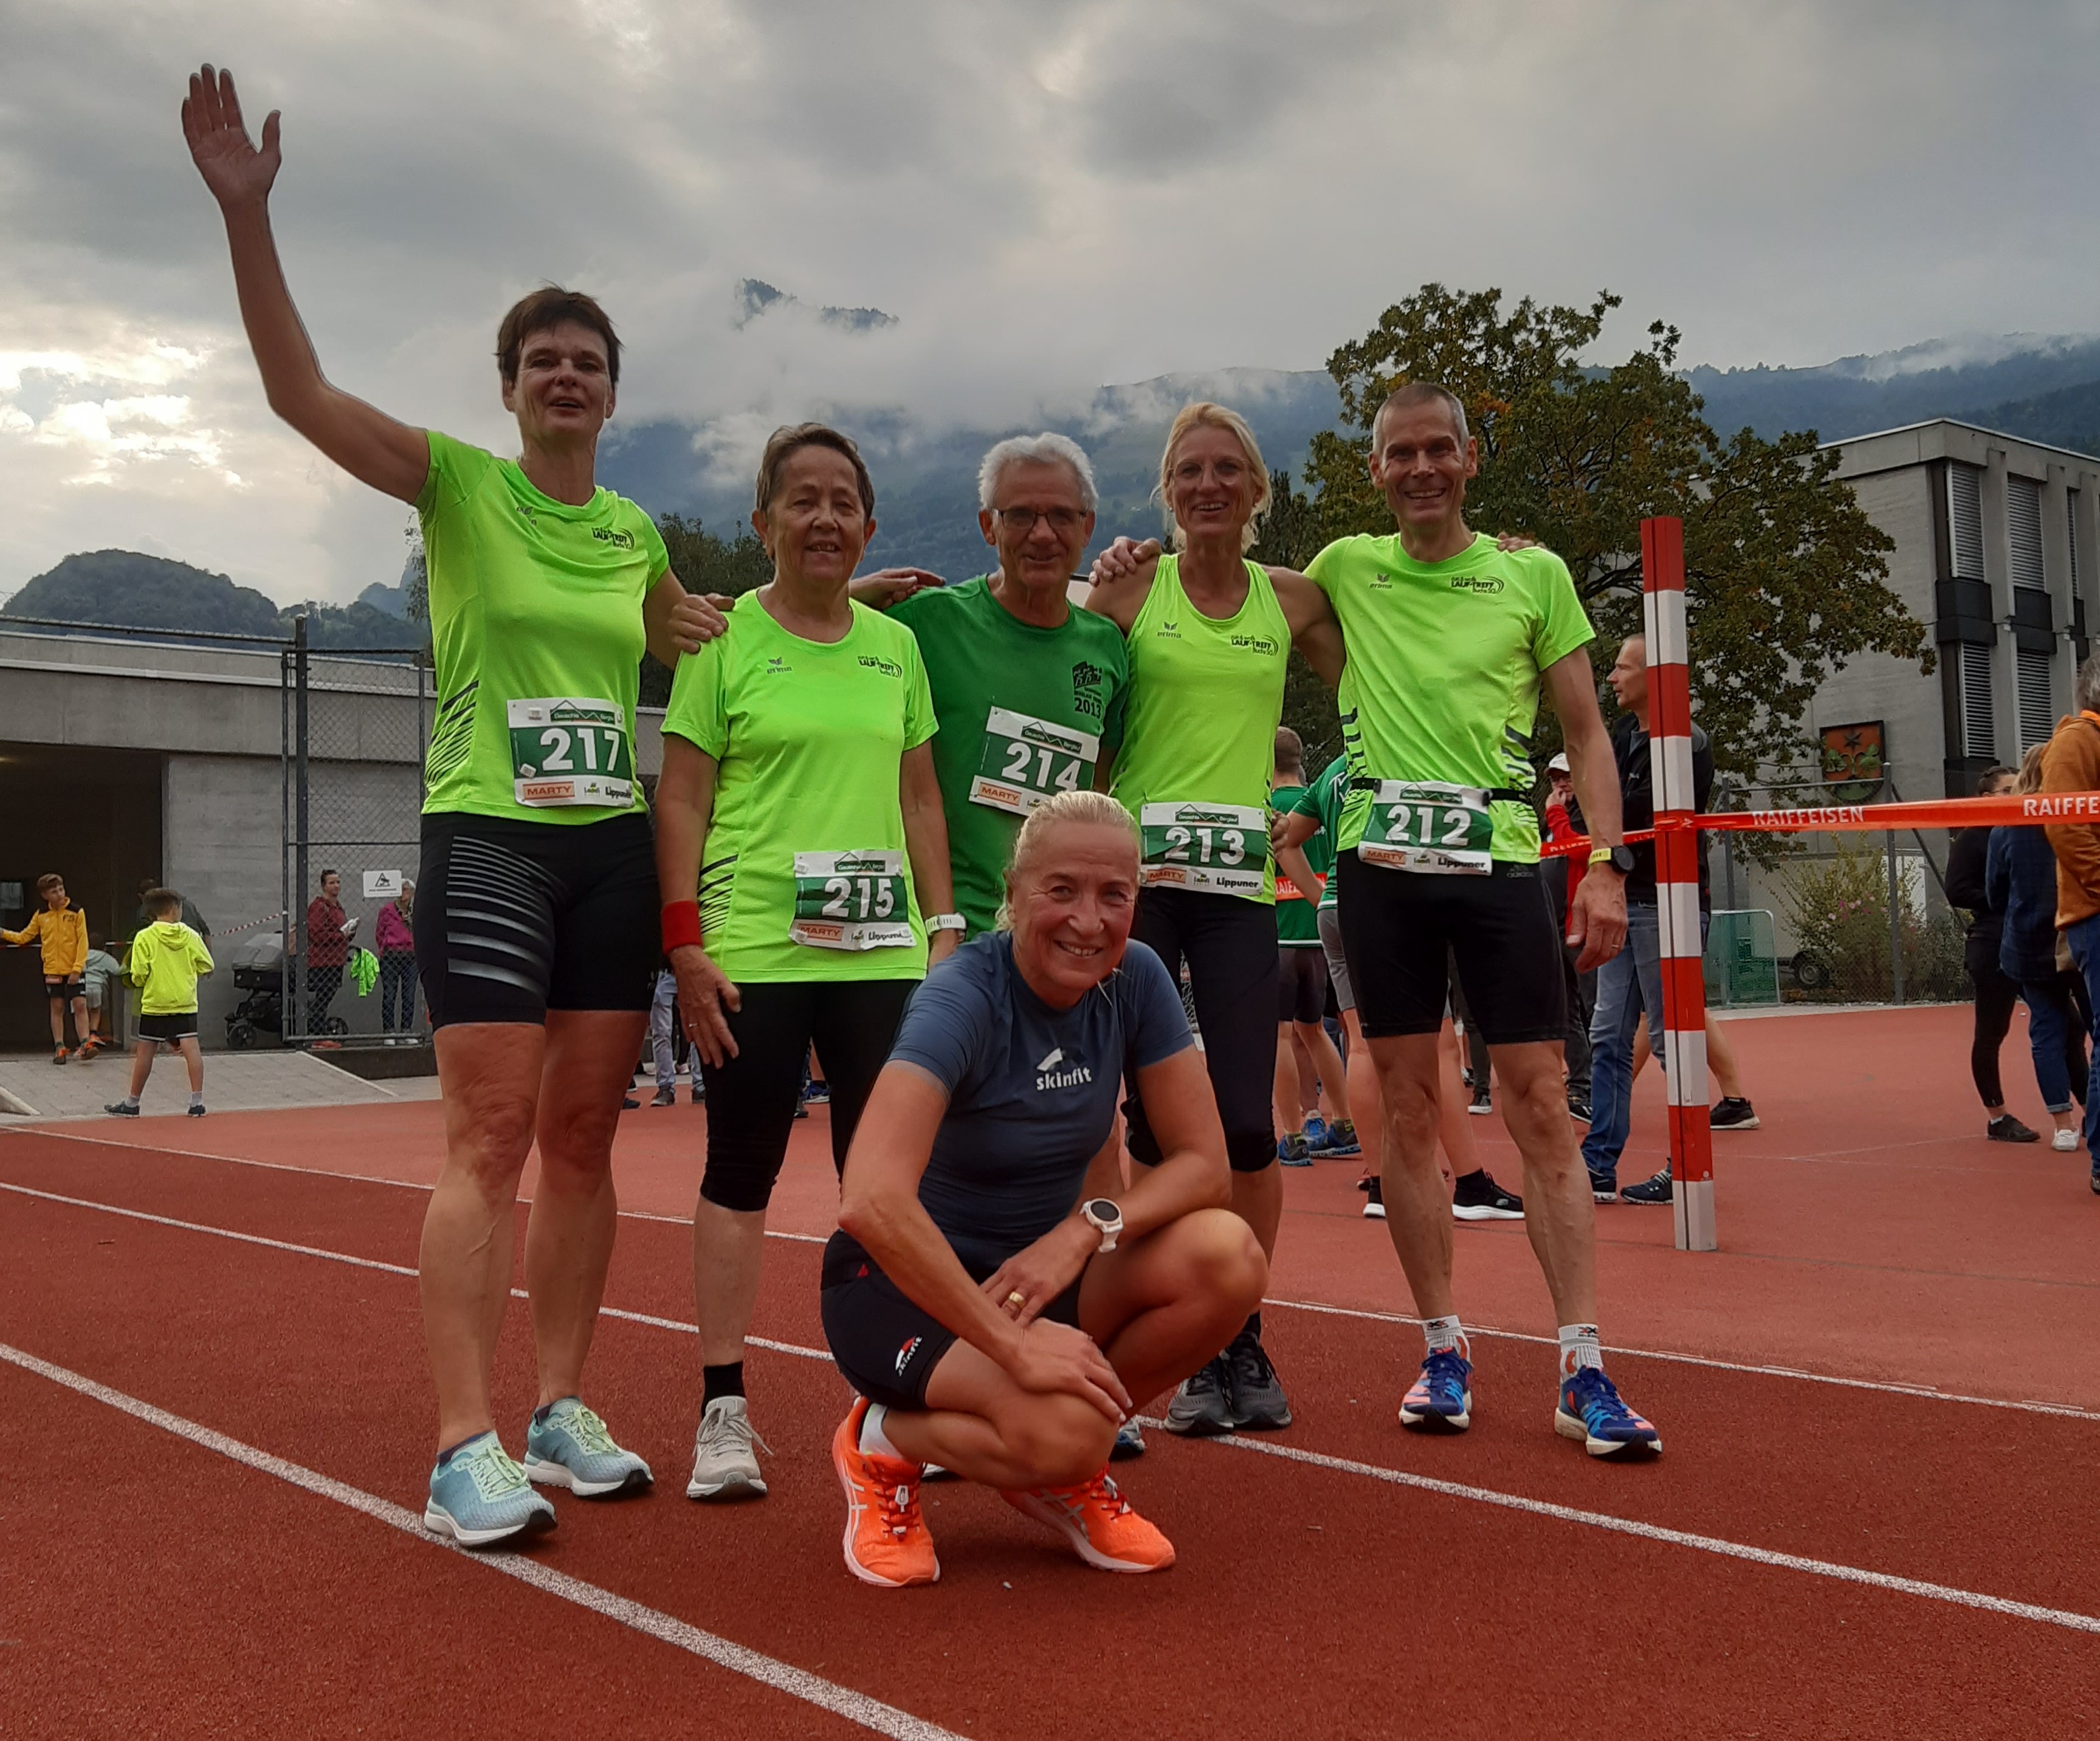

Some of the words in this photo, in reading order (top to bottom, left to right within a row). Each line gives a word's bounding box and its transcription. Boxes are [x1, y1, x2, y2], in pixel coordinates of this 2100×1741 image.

[1074, 696, 1101, 719] 2013
[540, 728, 620, 772] 217
[1001, 741, 1081, 792] 214
[527, 786, 571, 796] MARTY
[982, 786, 1019, 801] MARTY
[1385, 804, 1472, 846] 212
[1752, 807, 1864, 826] RAIFFEISEN
[1165, 826, 1245, 865] 213
[1367, 850, 1404, 861] MARTY
[1437, 857, 1485, 868] Lippuner
[1149, 870, 1185, 879] MARTY
[1216, 876, 1259, 888] Lippuner
[821, 877, 894, 918] 215
[800, 926, 841, 937] MARTY
[1036, 1067, 1092, 1091] skinfit
